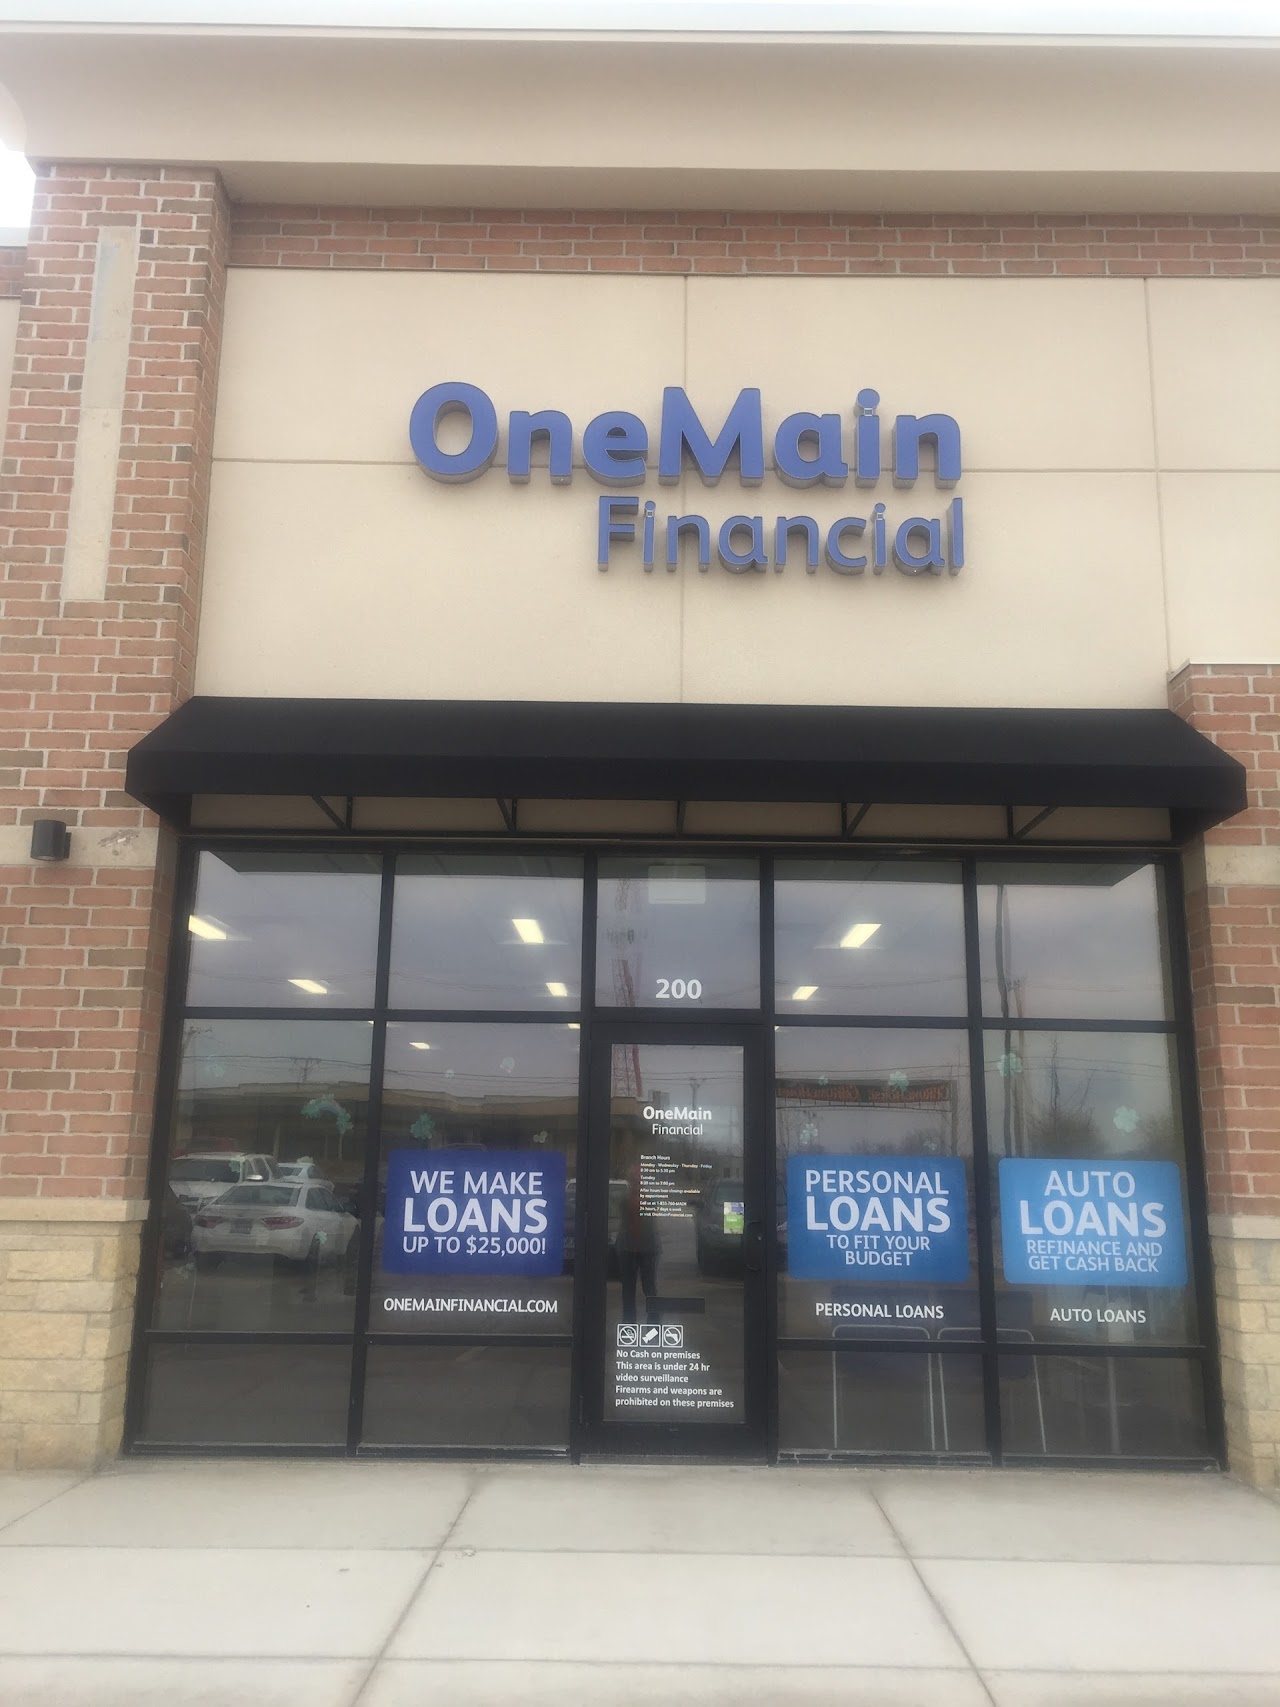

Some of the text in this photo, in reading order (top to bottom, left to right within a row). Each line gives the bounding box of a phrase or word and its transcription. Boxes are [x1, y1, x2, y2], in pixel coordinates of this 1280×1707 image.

[409, 381, 962, 488] OneMain
[597, 495, 965, 575] Financial
[656, 978, 702, 1000] 200
[643, 1106, 712, 1120] OneMain
[652, 1124, 703, 1135] Financial
[410, 1170, 544, 1194] WE MAKE
[805, 1170, 949, 1195] PERSONAL
[1044, 1170, 1136, 1198] AUTO
[403, 1198, 548, 1234] LOANS
[806, 1196, 951, 1234] LOANS
[1020, 1200, 1167, 1238] LOANS
[402, 1234, 546, 1257] UP TO $25,000!
[826, 1234, 930, 1251] TO FIT YOUR
[1026, 1240, 1162, 1257] REFINANCE AND
[845, 1250, 914, 1266] BUDGET
[1028, 1256, 1159, 1273] GET CASH BACK
[384, 1298, 558, 1313] ONEMAINFINANCIAL.COM
[815, 1303, 944, 1319] PERSONAL LOANS
[1050, 1308, 1147, 1323] AUTO LOANS
[616, 1350, 628, 1358] No
[630, 1350, 649, 1358] Cash
[664, 1351, 700, 1360] premises
[616, 1362, 632, 1370] This
[701, 1363, 710, 1371] hr
[616, 1373, 689, 1383] video surveillance
[616, 1385, 651, 1394] Firearms
[653, 1386, 668, 1394] and
[670, 1388, 707, 1396] weapons
[615, 1398, 658, 1406] prohibited
[672, 1398, 696, 1407] these
[697, 1399, 734, 1408] premises
